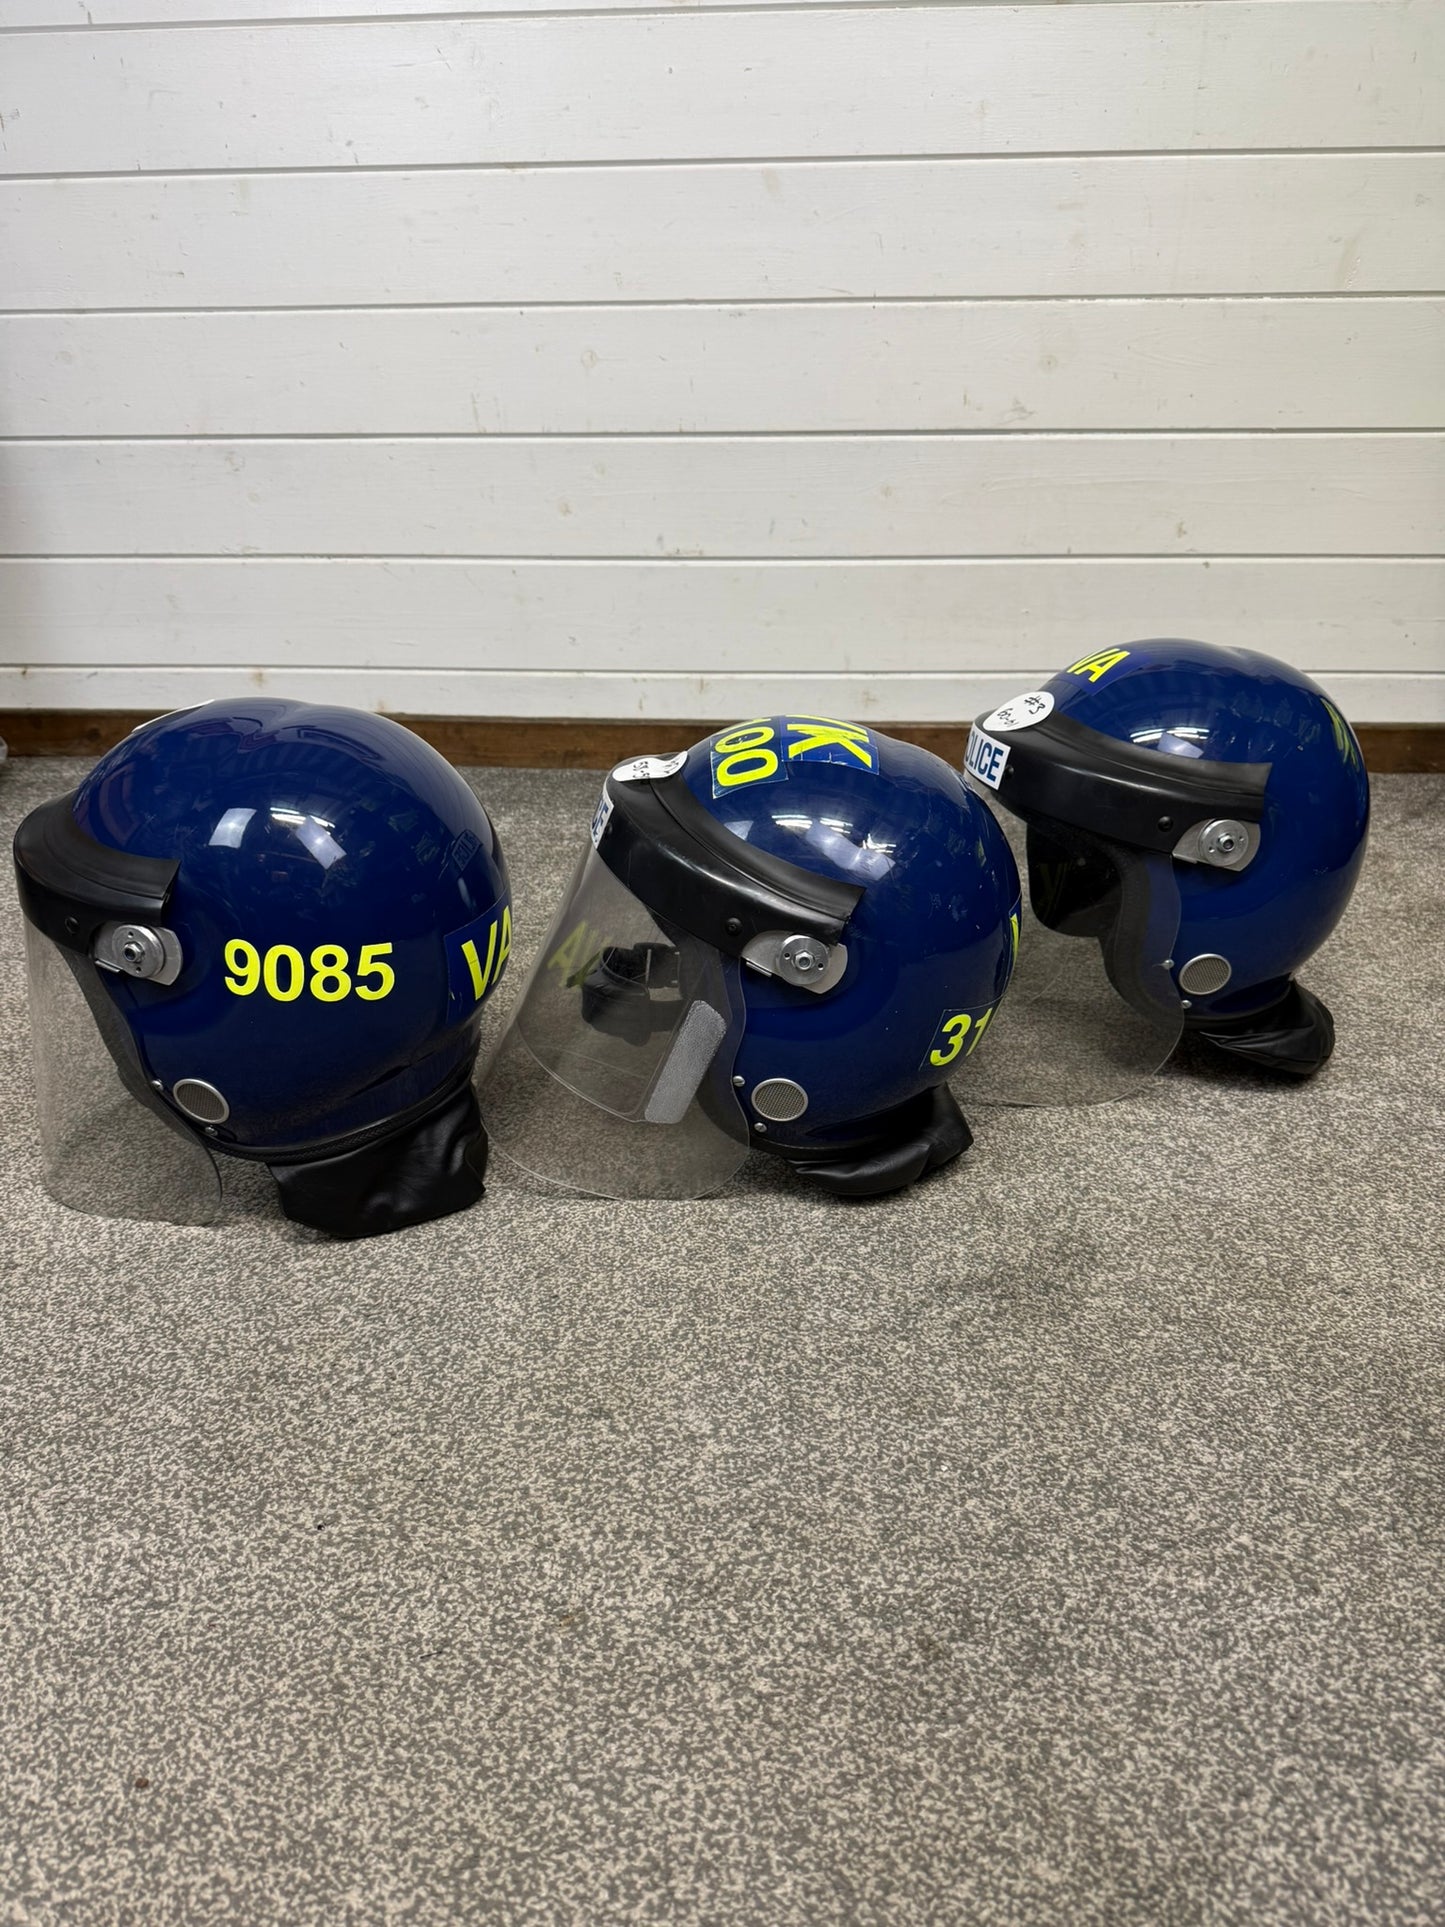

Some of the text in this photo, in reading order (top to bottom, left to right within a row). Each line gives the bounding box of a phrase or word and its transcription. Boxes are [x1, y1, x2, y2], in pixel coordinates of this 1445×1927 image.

[1024, 695, 1046, 715] #3
[965, 730, 1004, 783] OLICE
[224, 938, 395, 1002] 9085
[461, 905, 512, 1001] VA
